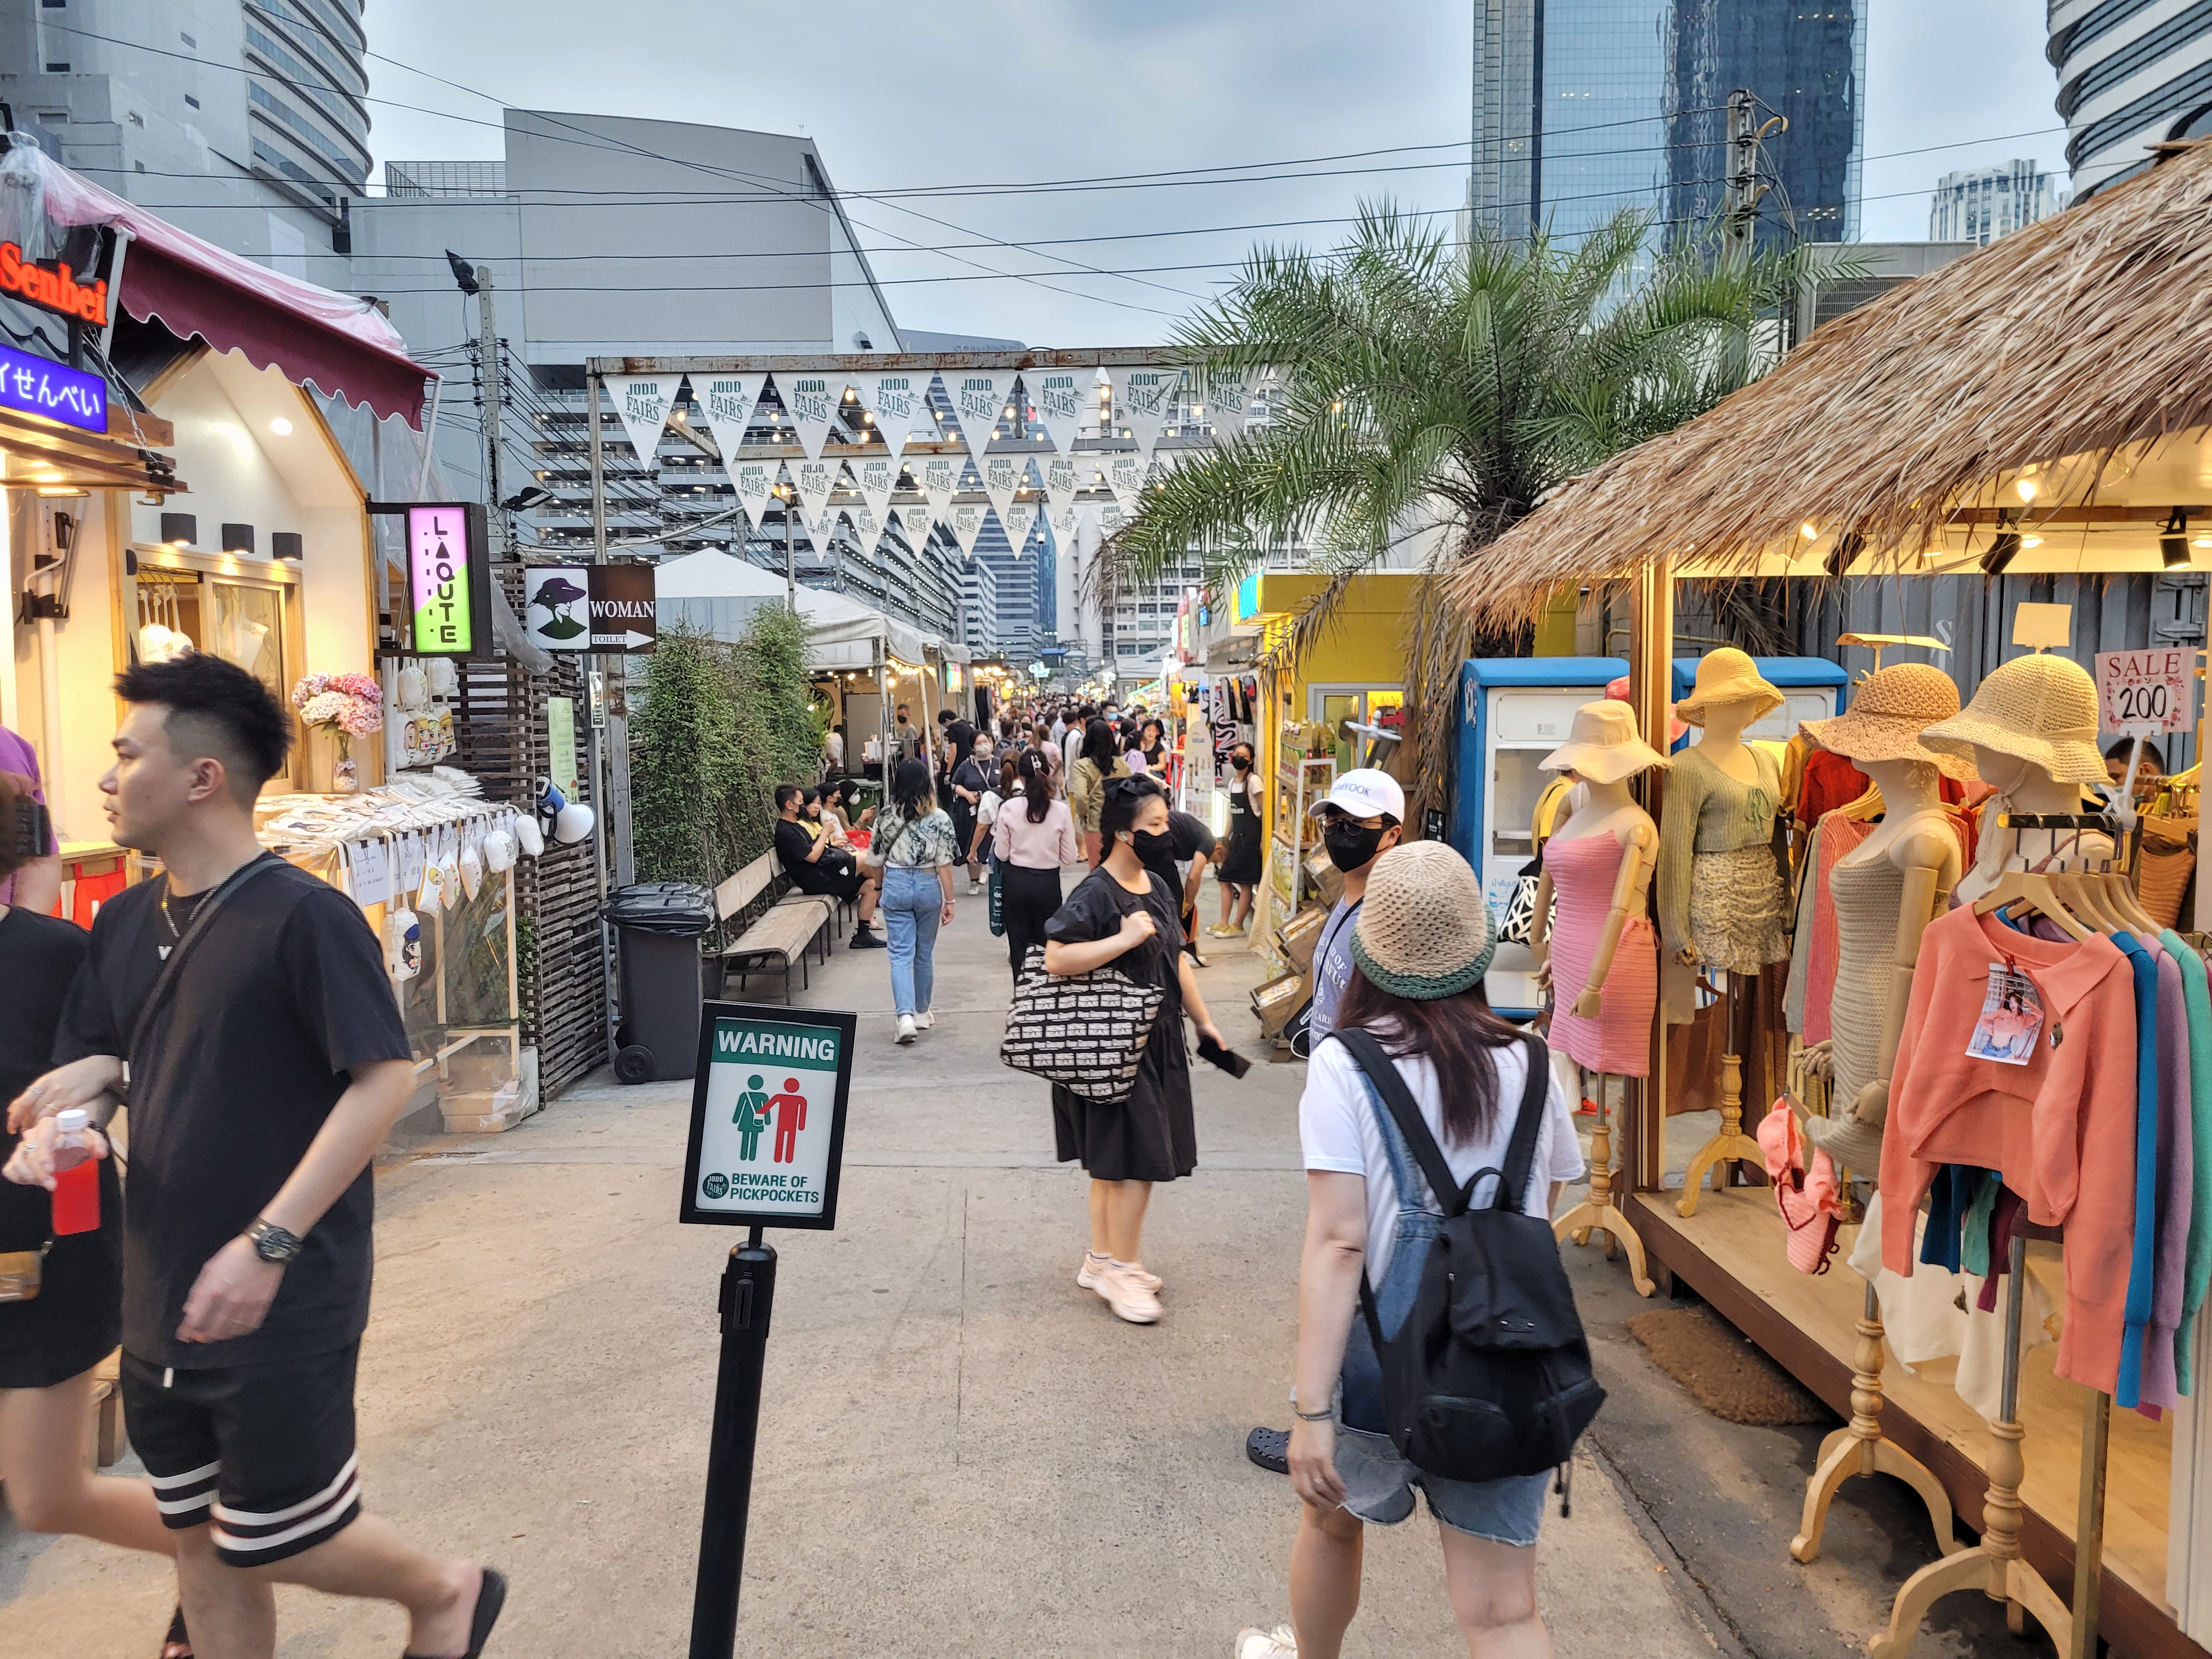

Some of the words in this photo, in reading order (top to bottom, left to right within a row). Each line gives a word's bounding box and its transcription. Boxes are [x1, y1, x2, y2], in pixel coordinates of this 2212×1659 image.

[710, 381, 741, 393] JODD
[794, 380, 825, 392] JODD
[878, 379, 909, 390] JODD
[961, 379, 992, 391] JODD
[1042, 376, 1073, 388] JODD
[1127, 374, 1158, 386] JODD
[626, 383, 657, 395] JODD
[710, 393, 743, 420] FAIRS
[794, 392, 827, 419] FAIRS
[878, 390, 910, 415] FAIRS
[961, 391, 992, 416] FAIRS
[1042, 389, 1075, 414] FAIRS
[1127, 386, 1160, 412] FAIRS
[626, 396, 659, 421] FAIRS
[741, 466, 763, 476] JODD
[864, 462, 887, 471] JODD
[926, 461, 949, 470] JODD
[988, 459, 1011, 469] JODD
[1112, 459, 1135, 469] JODD
[740, 476, 765, 494] FAIRS
[801, 473, 826, 493] FAIRS
[864, 472, 888, 490] FAIRS
[926, 470, 950, 489] FAIRS
[988, 469, 1012, 488] FAIRS
[1049, 469, 1073, 490] FAIRS
[1112, 469, 1137, 487] FAIRS
[859, 517, 878, 532] FAIRS
[907, 516, 926, 531] FAIRS
[956, 515, 975, 531] FAIRS
[1007, 515, 1026, 530] FAIRS
[590, 601, 655, 618] WOMAN
[2108, 653, 2181, 678] SALE
[2119, 685, 2166, 719] 200
[718, 1030, 835, 1061] WARNING
[707, 1180, 723, 1196] FAIRS
[731, 1173, 787, 1187] BEWARE
[791, 1176, 808, 1188] OF
[730, 1188, 819, 1203] PICKPOCKETS
